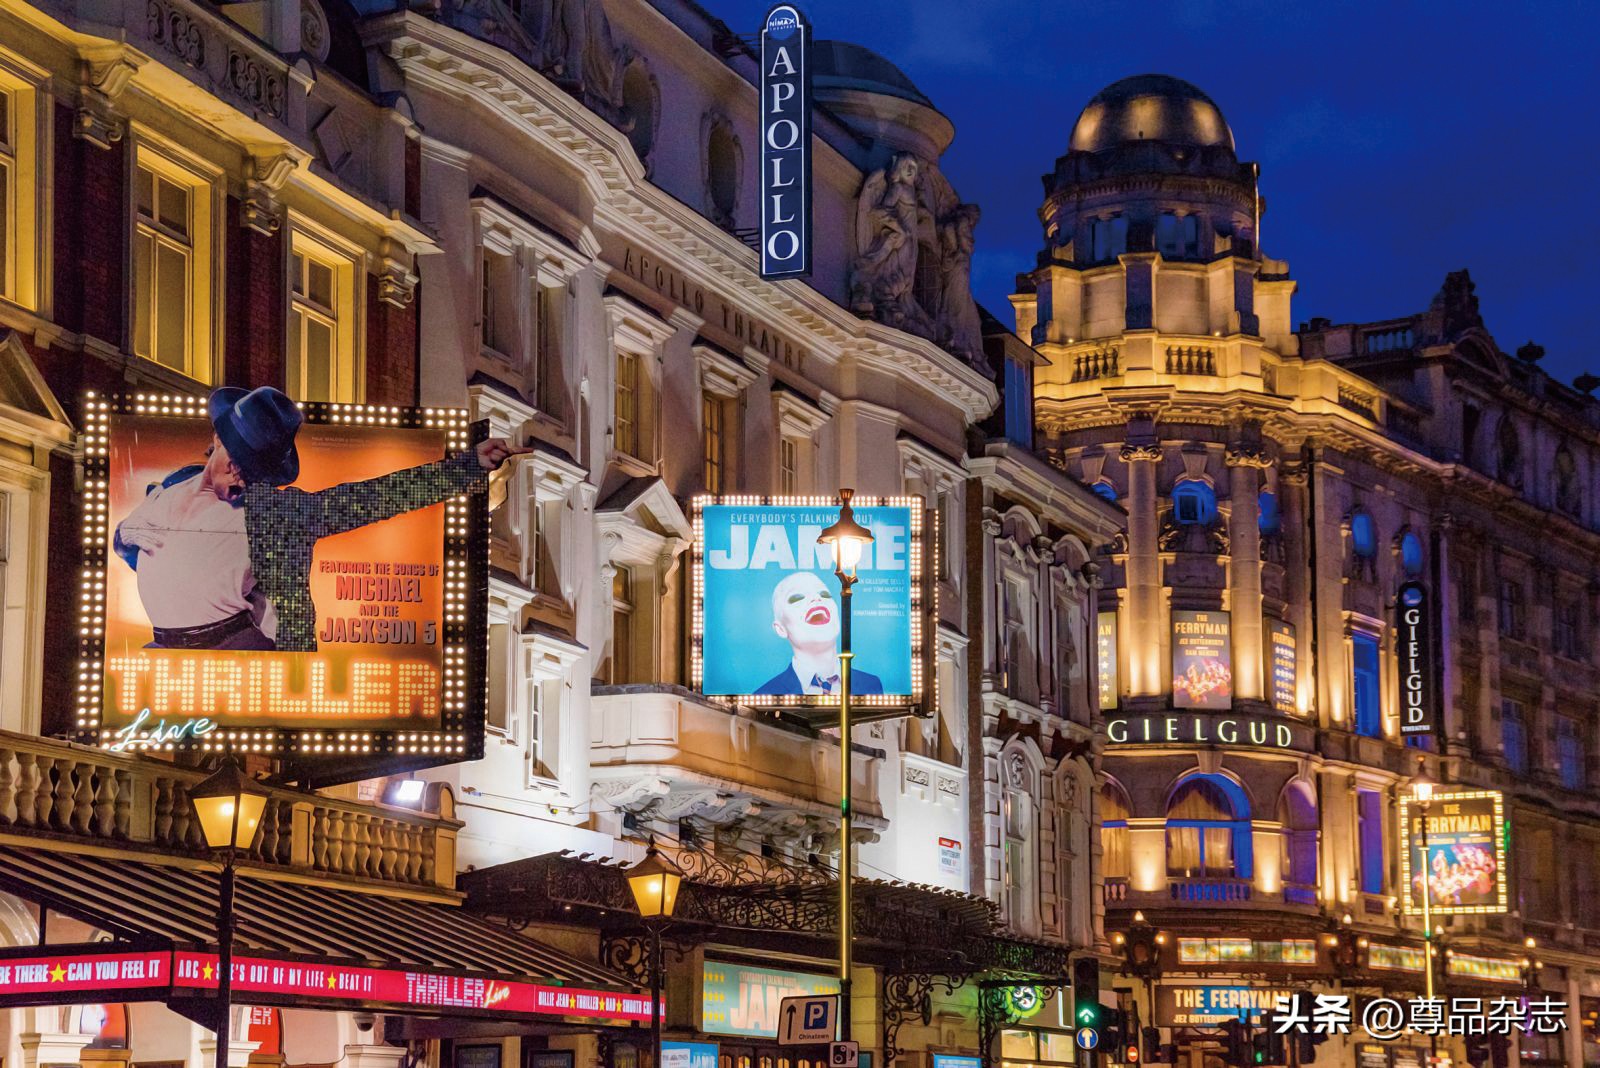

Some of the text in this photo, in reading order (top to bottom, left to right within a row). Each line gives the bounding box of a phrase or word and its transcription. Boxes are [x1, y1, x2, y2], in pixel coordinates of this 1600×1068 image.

[767, 46, 799, 261] APOLLO
[624, 248, 704, 315] APOLLO
[731, 513, 796, 524] EVERYBODY'S
[320, 560, 440, 577] FEATURING THE SONGS OF
[335, 575, 422, 603] MICHAEL
[360, 604, 400, 617] AND THE
[320, 617, 438, 645] JACKSON 5
[1175, 622, 1228, 635] FERRYMAN
[1404, 608, 1425, 724] GIELGUD
[110, 657, 437, 717] THRILLER
[110, 707, 217, 751] Live
[1107, 717, 1293, 747] GIELGUD
[1443, 804, 1460, 815] THE
[15, 964, 49, 983] THERE
[67, 962, 92, 982] CAN
[95, 960, 119, 980] YOU
[121, 960, 145, 979] FEEL
[148, 959, 161, 978] IT
[178, 960, 199, 978] ABC
[250, 965, 269, 983] OUT
[273, 967, 285, 985] OF
[288, 969, 301, 986] MY
[305, 970, 325, 988] LIFE
[339, 973, 360, 991] BEAT
[364, 975, 373, 992] IT
[405, 972, 484, 1008] THRILLER
[1173, 989, 1205, 1008] THE
[808, 1004, 824, 1027] P
